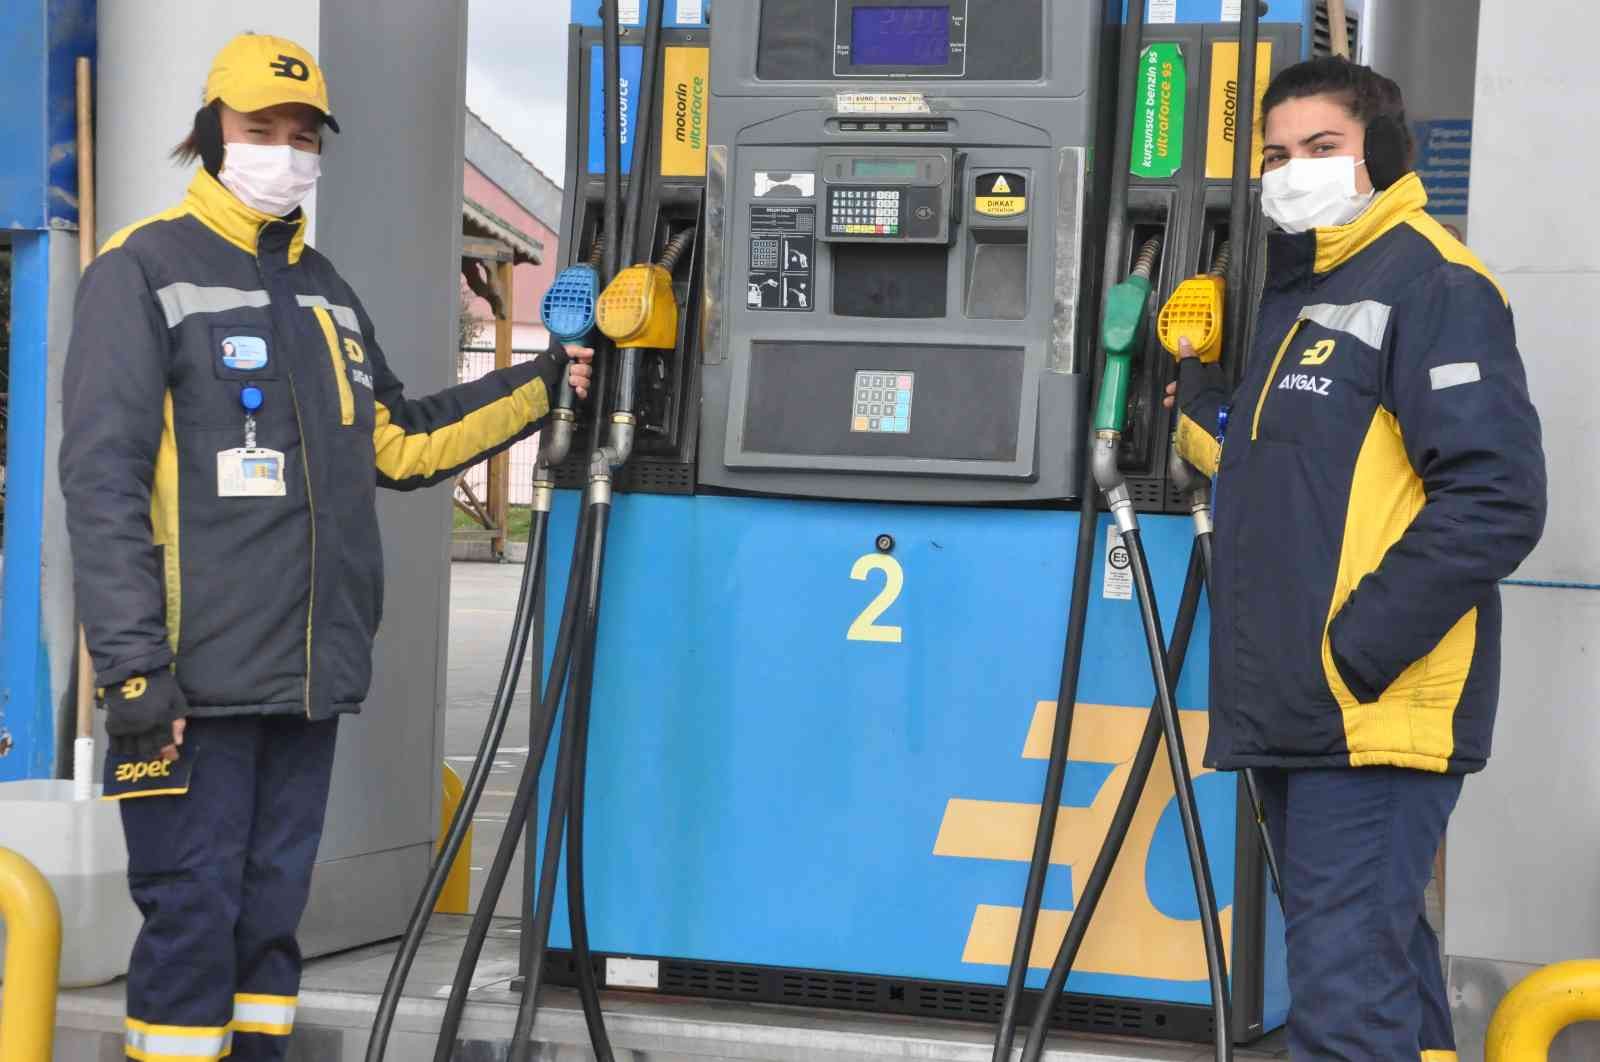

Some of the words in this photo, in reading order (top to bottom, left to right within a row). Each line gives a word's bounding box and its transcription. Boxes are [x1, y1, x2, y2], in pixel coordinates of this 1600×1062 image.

[1148, 51, 1158, 64] 95
[1162, 62, 1173, 78] 95
[1145, 66, 1157, 106] benzin
[675, 83, 688, 143] motorin
[689, 76, 704, 150] ultraforce
[1157, 80, 1170, 158] ultraforce
[1224, 80, 1237, 143] motorin
[1142, 107, 1155, 168] kurşunsuz
[1278, 373, 1333, 396] AYGAZ
[1113, 552, 1128, 563] E5
[847, 553, 904, 643] 2
[115, 759, 172, 783] opet
